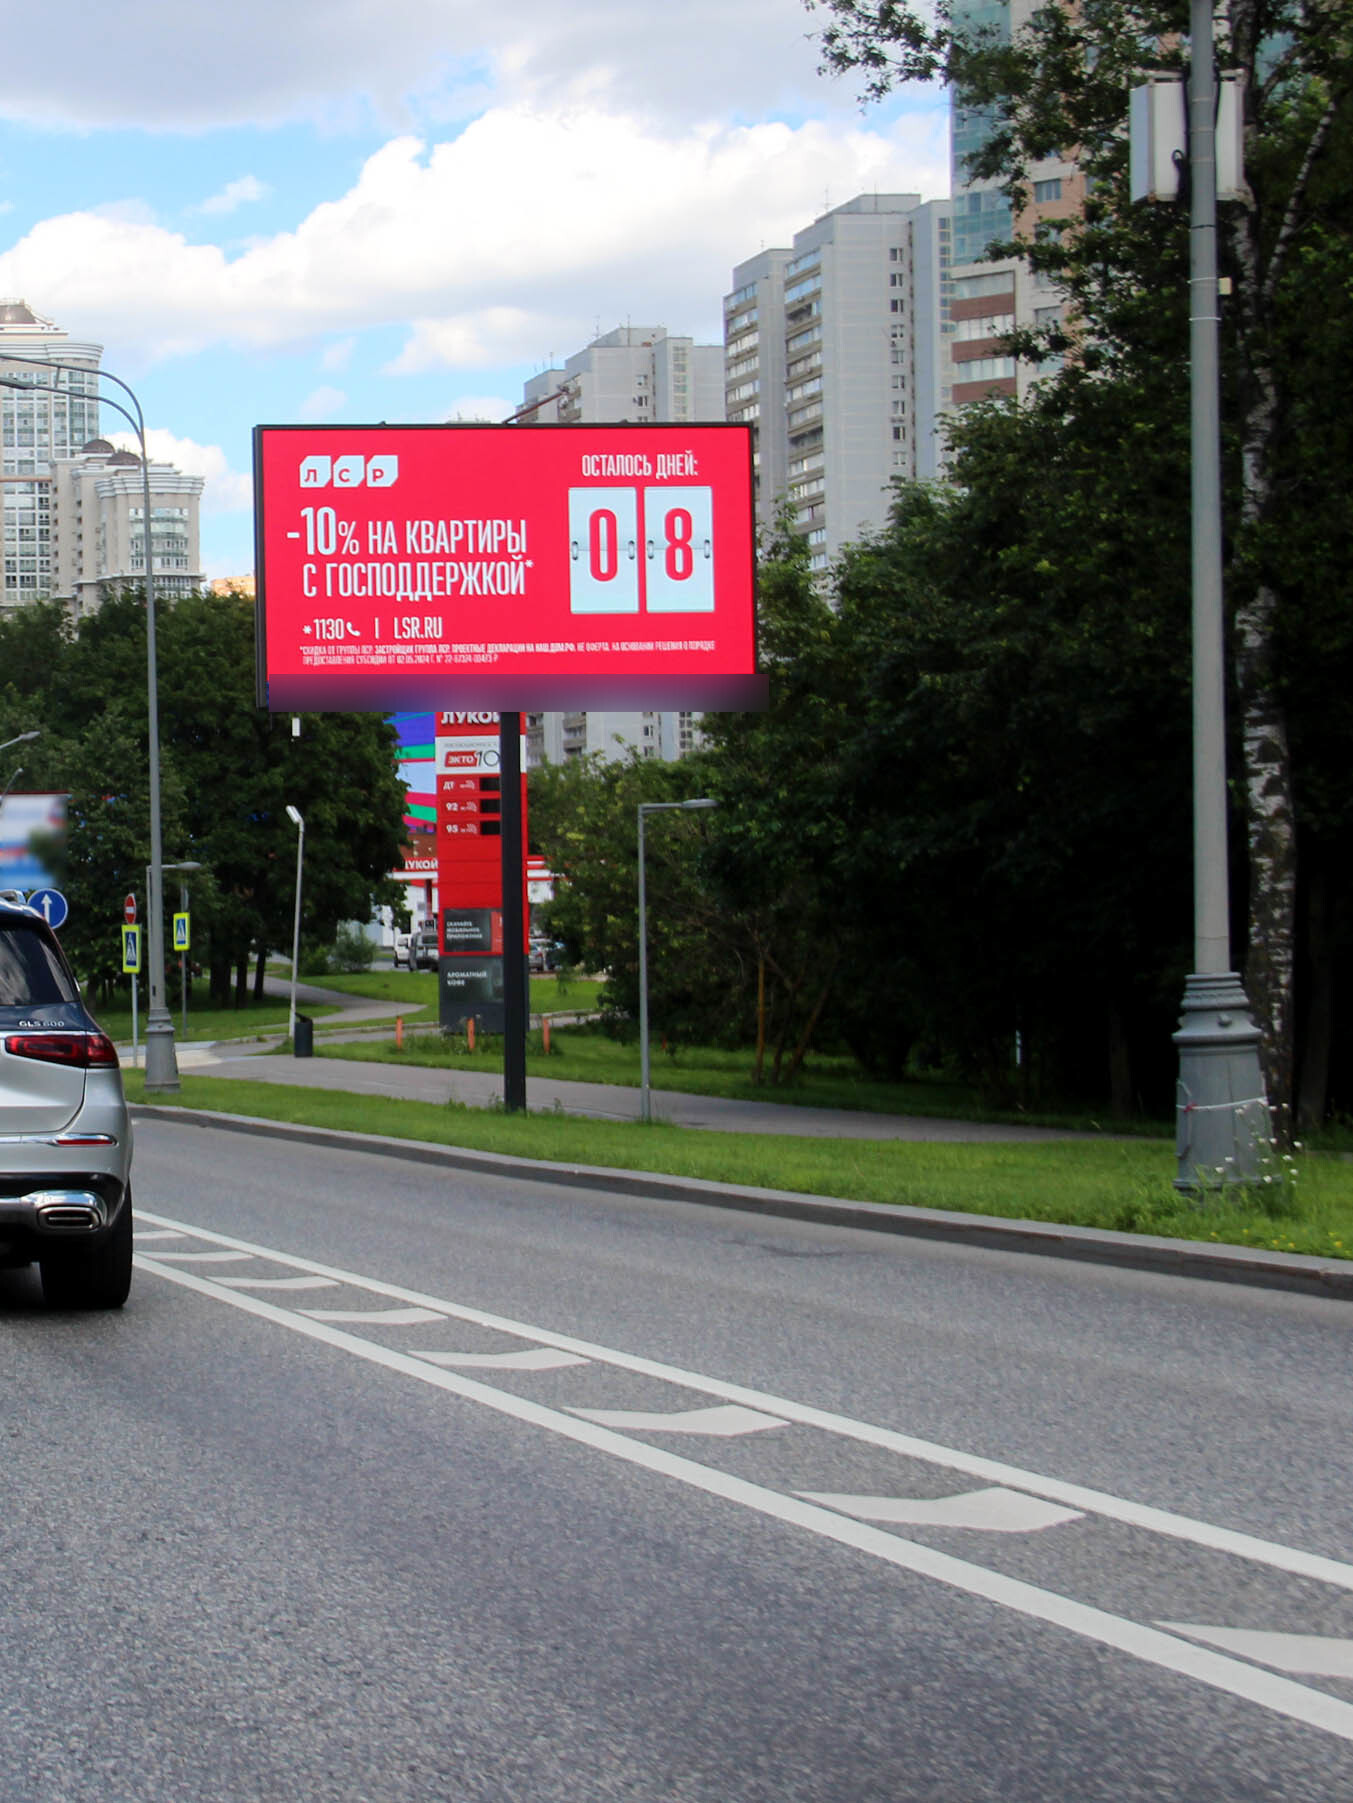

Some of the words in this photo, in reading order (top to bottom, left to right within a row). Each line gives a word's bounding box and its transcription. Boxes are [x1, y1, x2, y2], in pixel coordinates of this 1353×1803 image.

[582, 455, 651, 476] ОСТАЛОСЬ
[656, 450, 698, 479] ДНЕЙ:
[287, 507, 359, 555] -10%
[368, 521, 398, 554] НА
[406, 520, 526, 553] КВАРТИРЫ
[303, 563, 317, 597] С
[394, 617, 443, 639] LSR.RU
